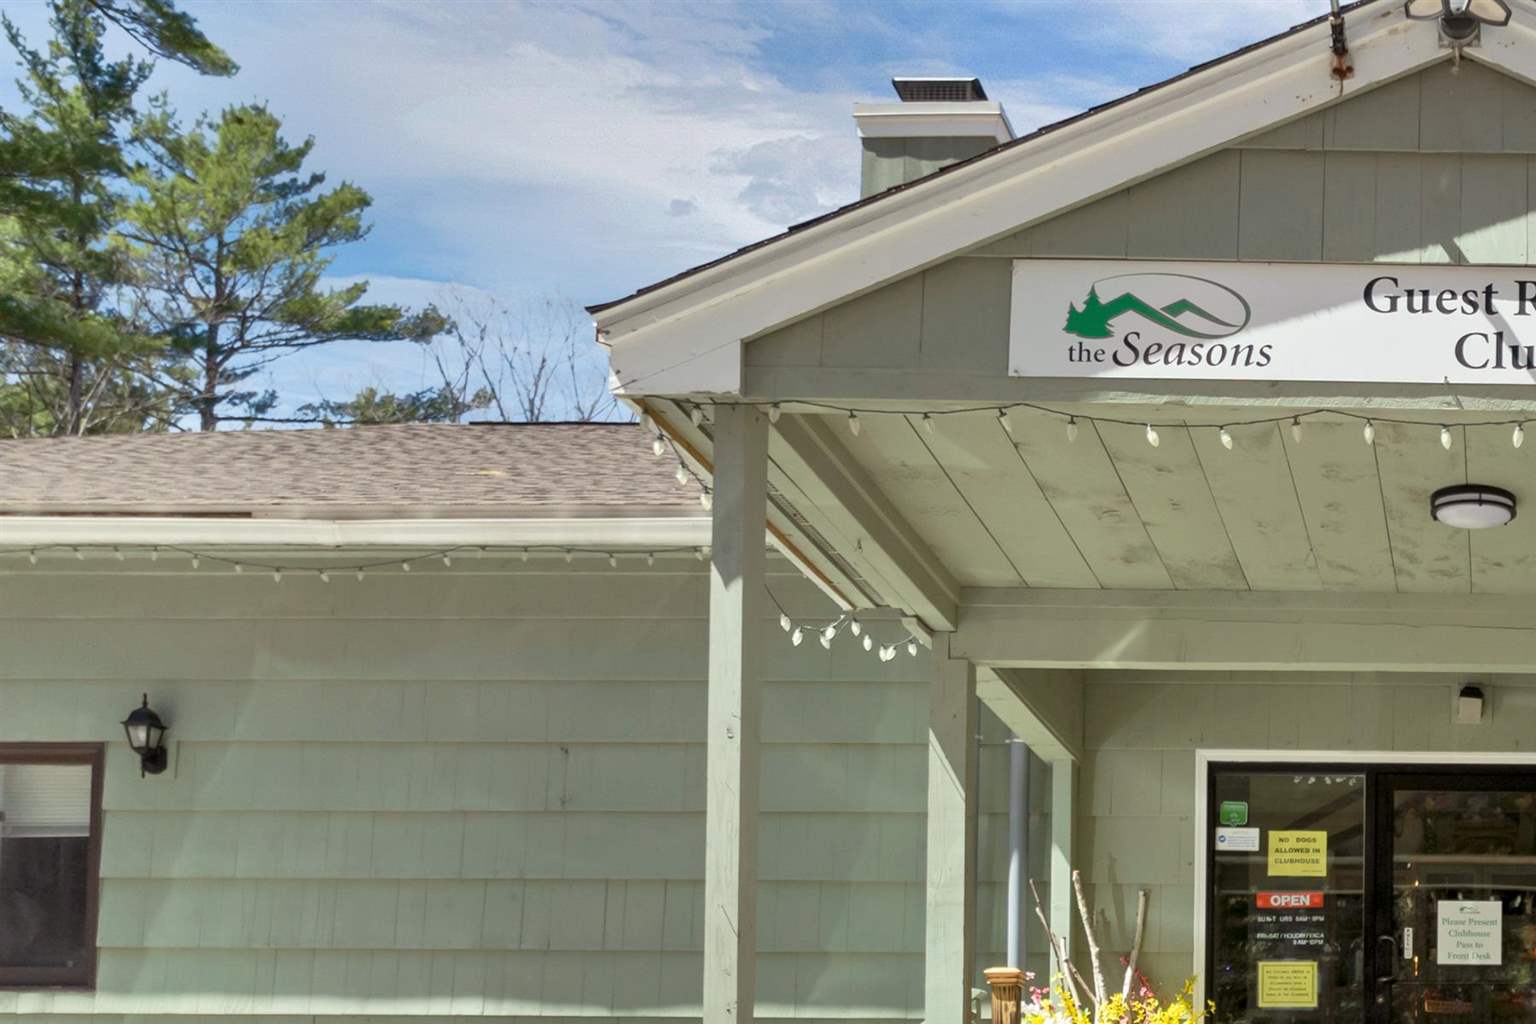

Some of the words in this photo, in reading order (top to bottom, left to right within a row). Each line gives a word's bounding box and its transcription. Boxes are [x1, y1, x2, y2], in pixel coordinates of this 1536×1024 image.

[1363, 276, 1499, 316] Guest
[1068, 341, 1106, 363] the
[1112, 331, 1273, 367] Seasons
[1270, 894, 1310, 906] OPEN
[1441, 918, 1466, 926] Please
[1468, 918, 1498, 927] Present
[1448, 930, 1491, 938] Clubhouse
[1447, 952, 1470, 960] Front
[1472, 952, 1491, 960] Desk
